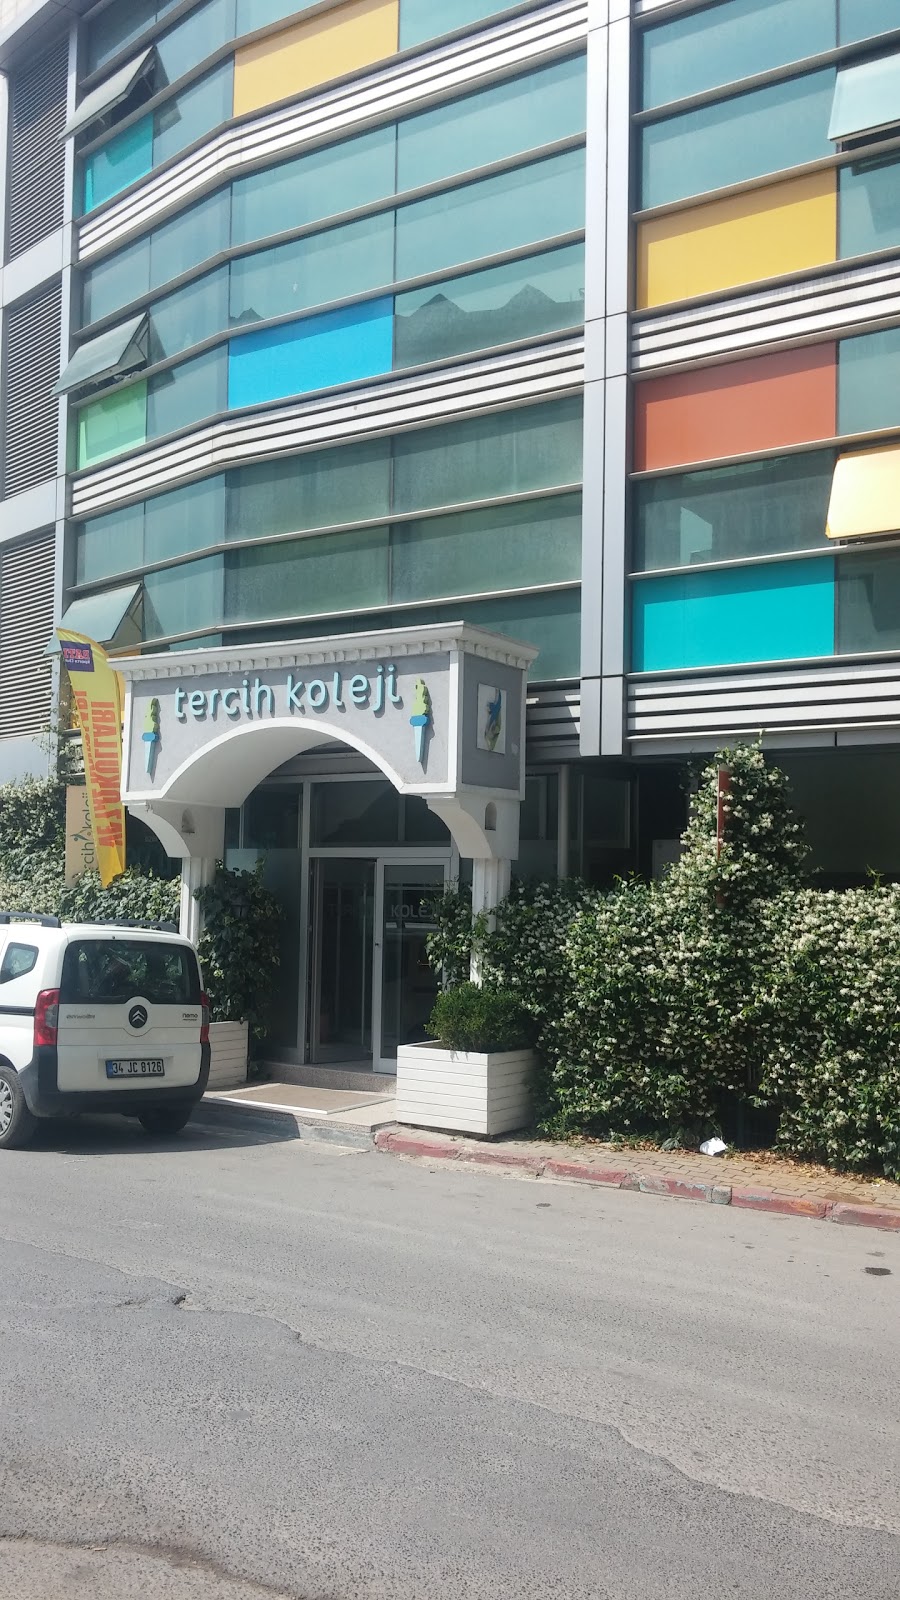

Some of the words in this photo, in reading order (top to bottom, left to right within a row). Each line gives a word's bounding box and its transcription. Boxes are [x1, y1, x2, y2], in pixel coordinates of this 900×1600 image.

[175, 677, 272, 718] tercih
[286, 664, 401, 712] koleji
[112, 1062, 123, 1073] 34
[128, 1061, 138, 1072] JC
[141, 1061, 162, 1072] 8126
